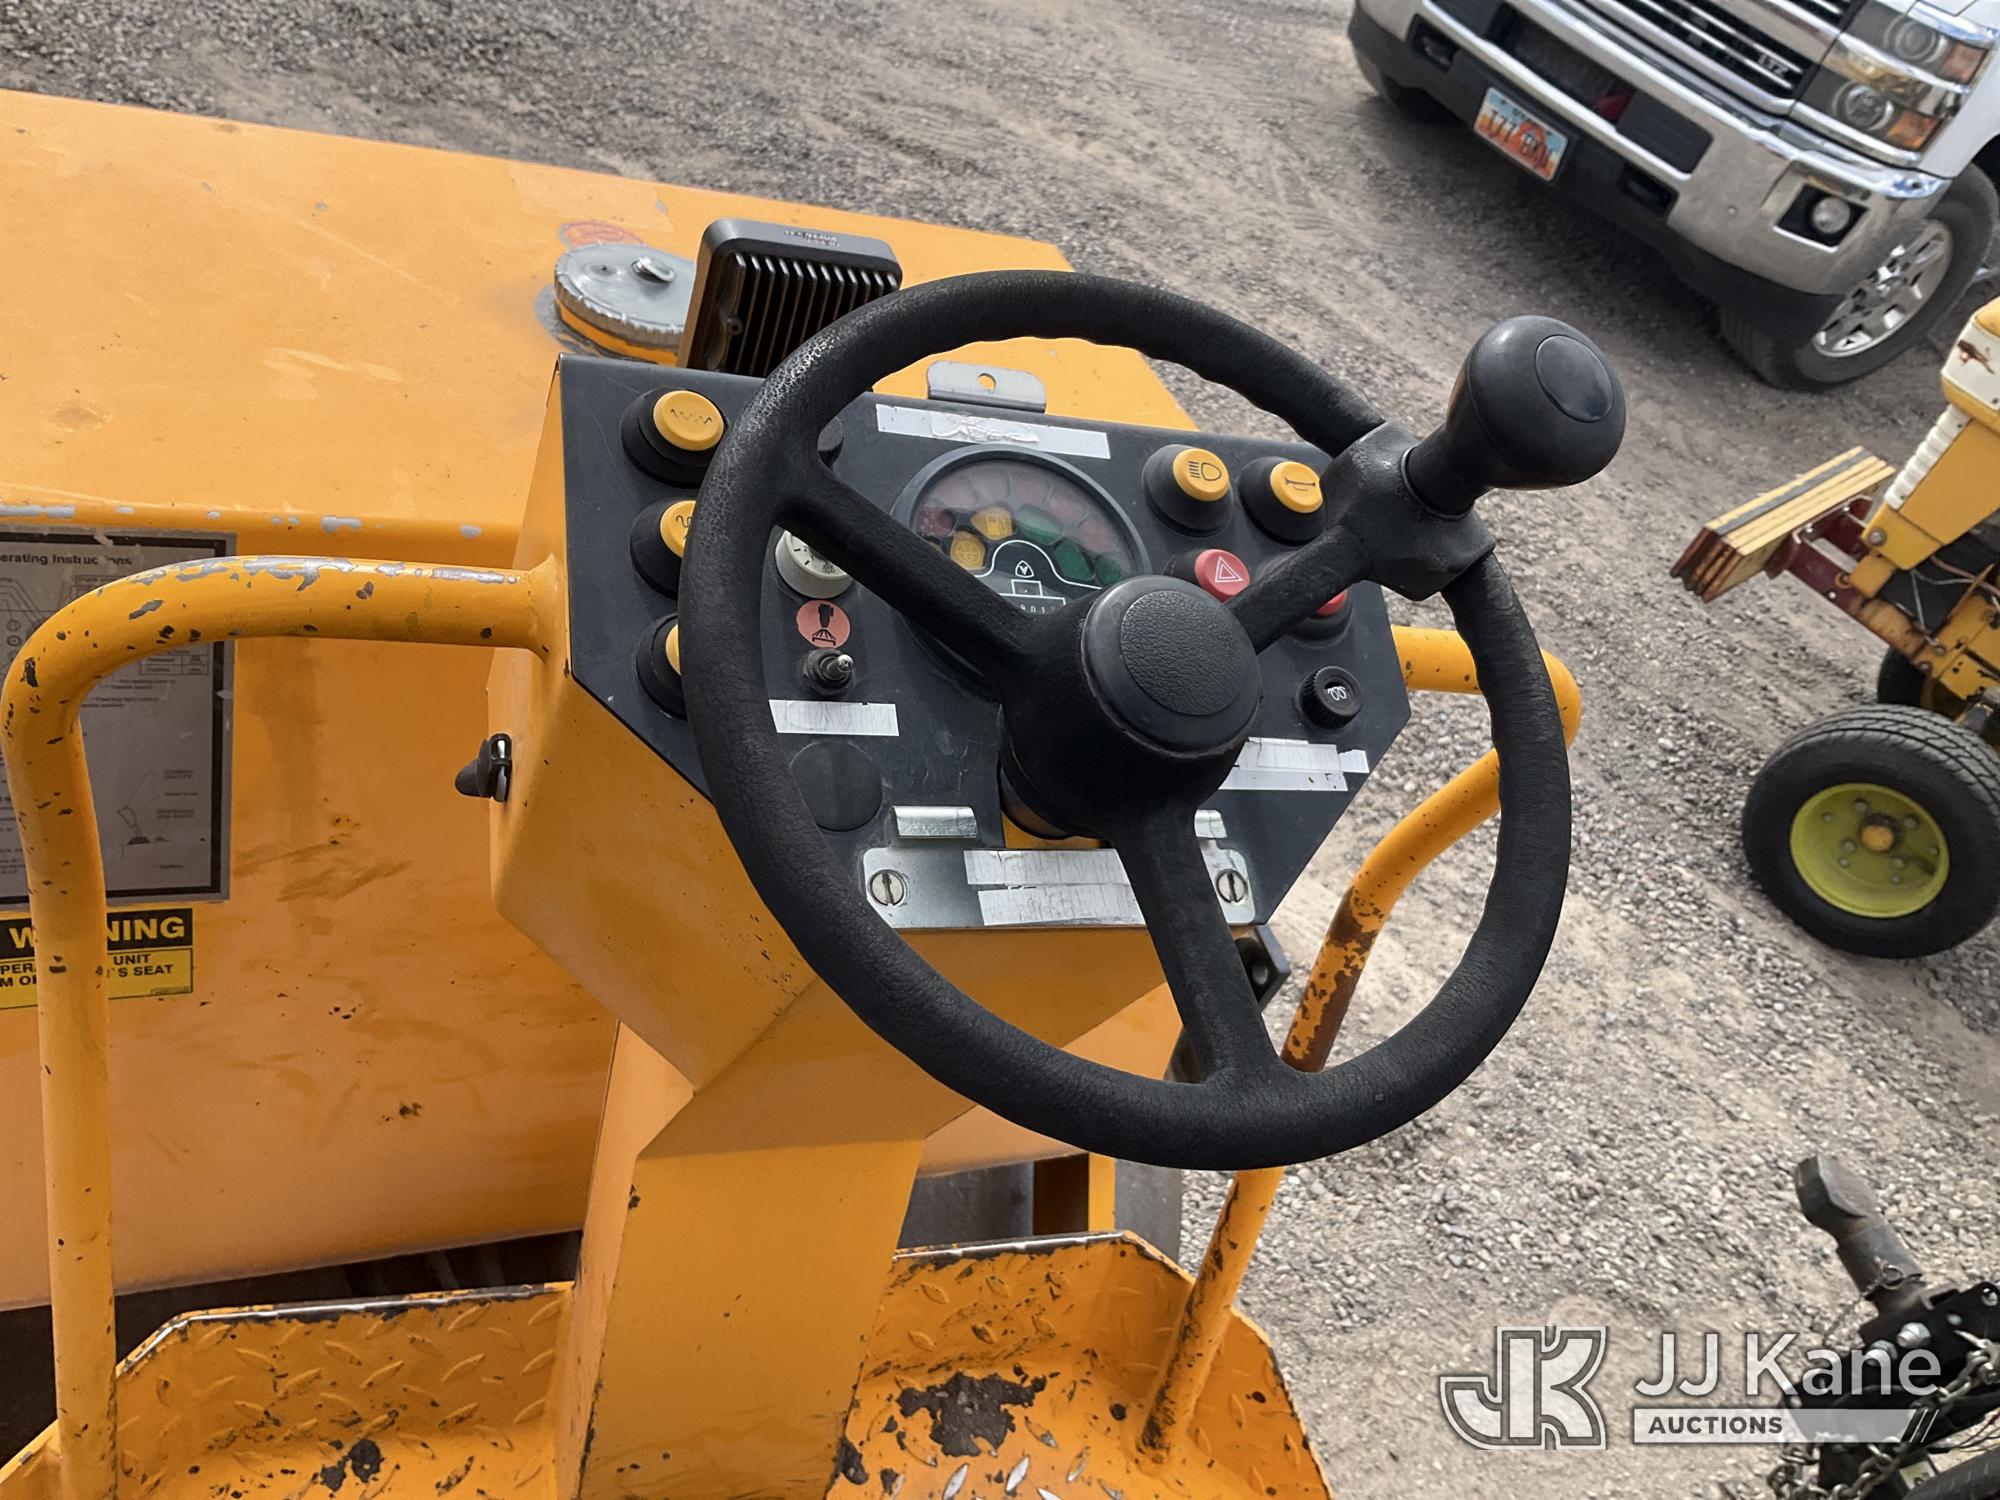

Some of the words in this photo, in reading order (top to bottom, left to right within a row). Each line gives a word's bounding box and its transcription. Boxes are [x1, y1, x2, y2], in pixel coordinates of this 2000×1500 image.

[53, 554, 133, 566] Instrucons
[9, 916, 185, 949] WNING
[113, 953, 151, 966] UNIT
[133, 963, 174, 976] SEAT
